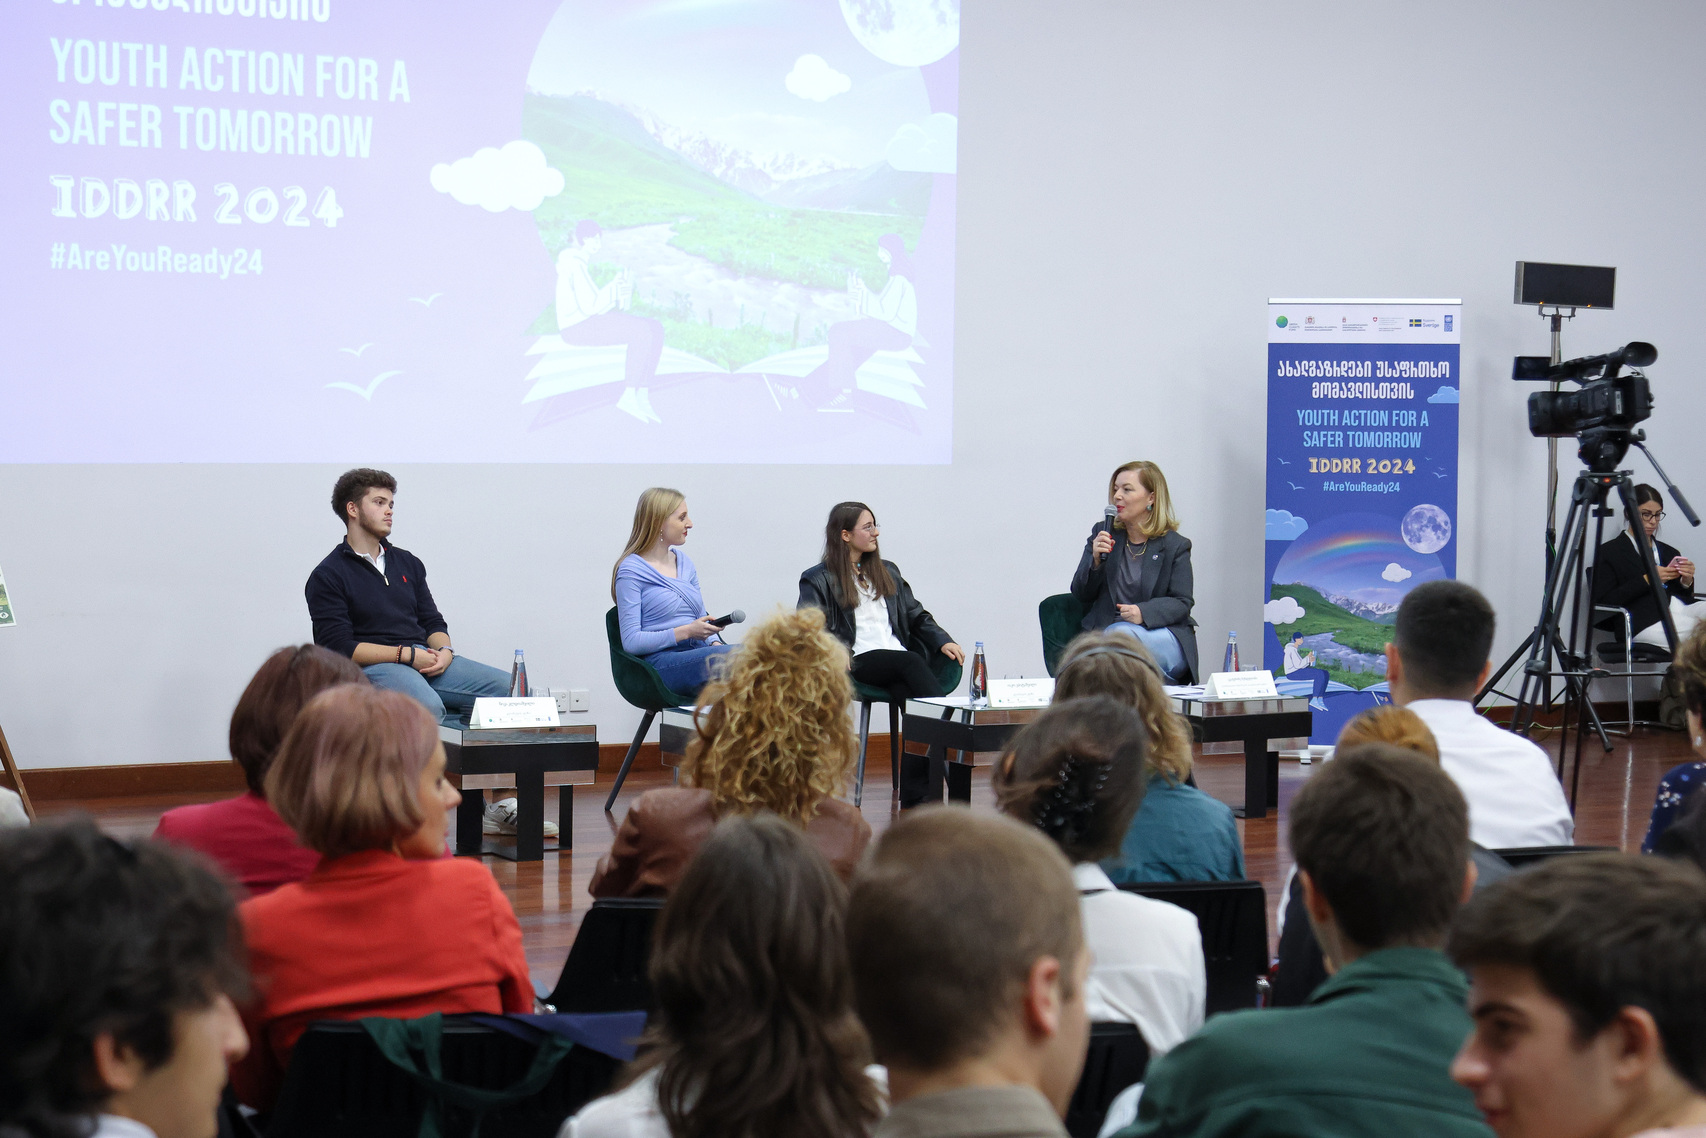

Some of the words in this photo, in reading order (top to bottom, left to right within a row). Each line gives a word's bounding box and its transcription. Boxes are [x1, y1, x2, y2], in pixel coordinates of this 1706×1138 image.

[50, 37, 168, 88] YOUTH
[179, 46, 304, 96] ACTION
[316, 55, 379, 101] FOR
[389, 59, 411, 103] A
[49, 99, 162, 148] SAFER
[173, 105, 373, 158] TOMORROW
[49, 175, 197, 222] IDDRR
[213, 182, 344, 228] 2024
[50, 242, 264, 279] #AreYouReady24
[1297, 409, 1338, 426] YOUTH
[1342, 410, 1388, 426] ACTION
[1392, 410, 1417, 426] FOR
[1420, 410, 1429, 426] A
[1303, 431, 1343, 447] SAFER
[1347, 431, 1421, 448] TOMORROW
[1309, 457, 1361, 473] IDDRR
[1367, 458, 1415, 474] 2024
[1323, 481, 1400, 494] #AreYouReady24
